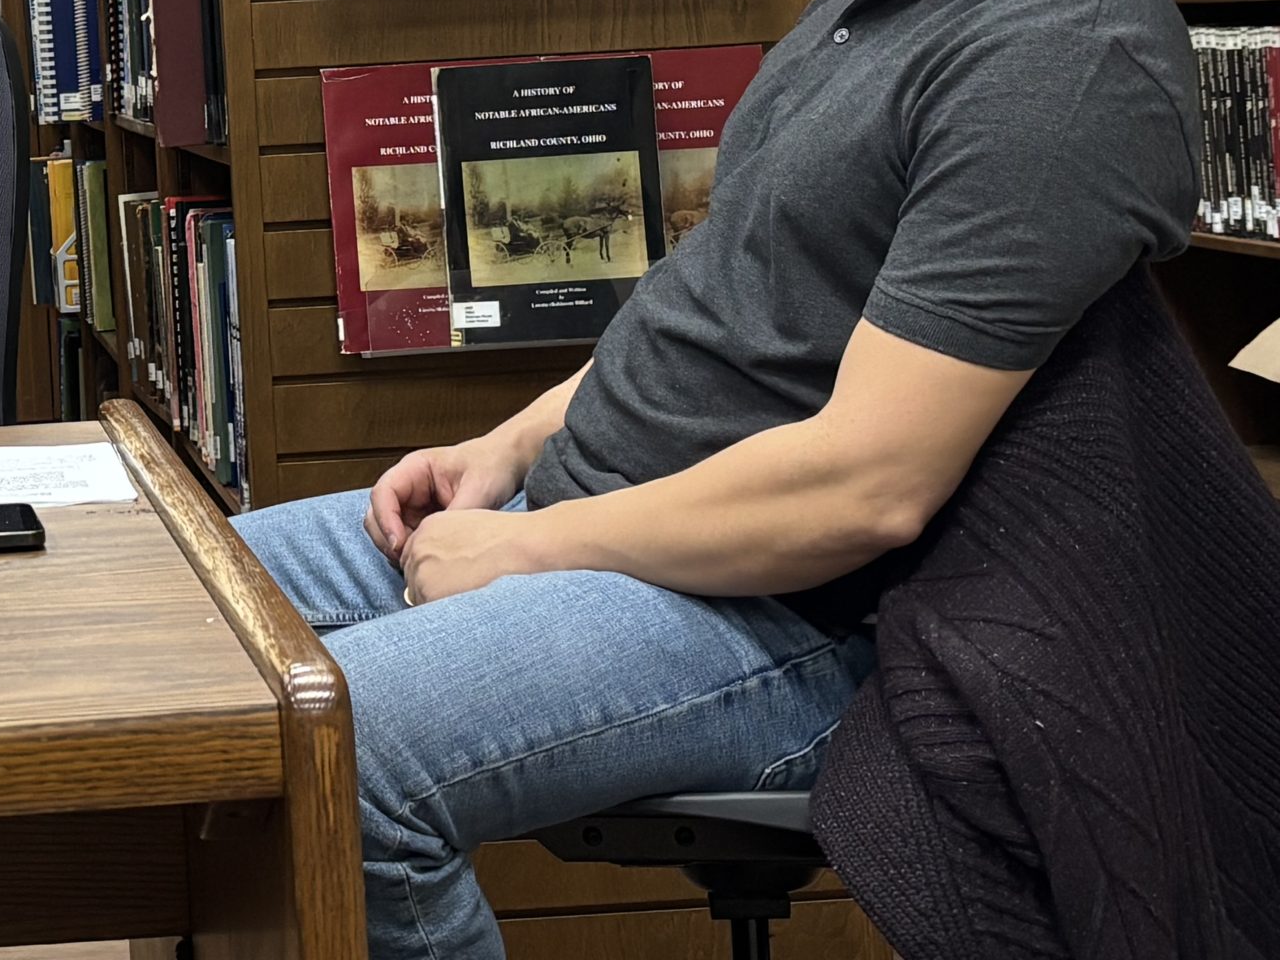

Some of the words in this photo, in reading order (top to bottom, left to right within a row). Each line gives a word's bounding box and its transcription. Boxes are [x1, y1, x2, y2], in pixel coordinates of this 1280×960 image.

[672, 81, 684, 90] OF
[512, 89, 520, 98] A
[521, 86, 561, 97] HISTORY
[562, 86, 576, 94] OF
[402, 96, 409, 104] A
[474, 110, 518, 120] NOTABLE
[518, 103, 617, 118] AFRICAN-AMERICANS
[365, 116, 408, 127] NOTABLE
[690, 130, 714, 138] OHIO
[490, 140, 538, 150] RICHLAND
[540, 136, 581, 146] COUNTY,
[582, 134, 606, 144] OHIO
[380, 145, 427, 156] RICHLAND
